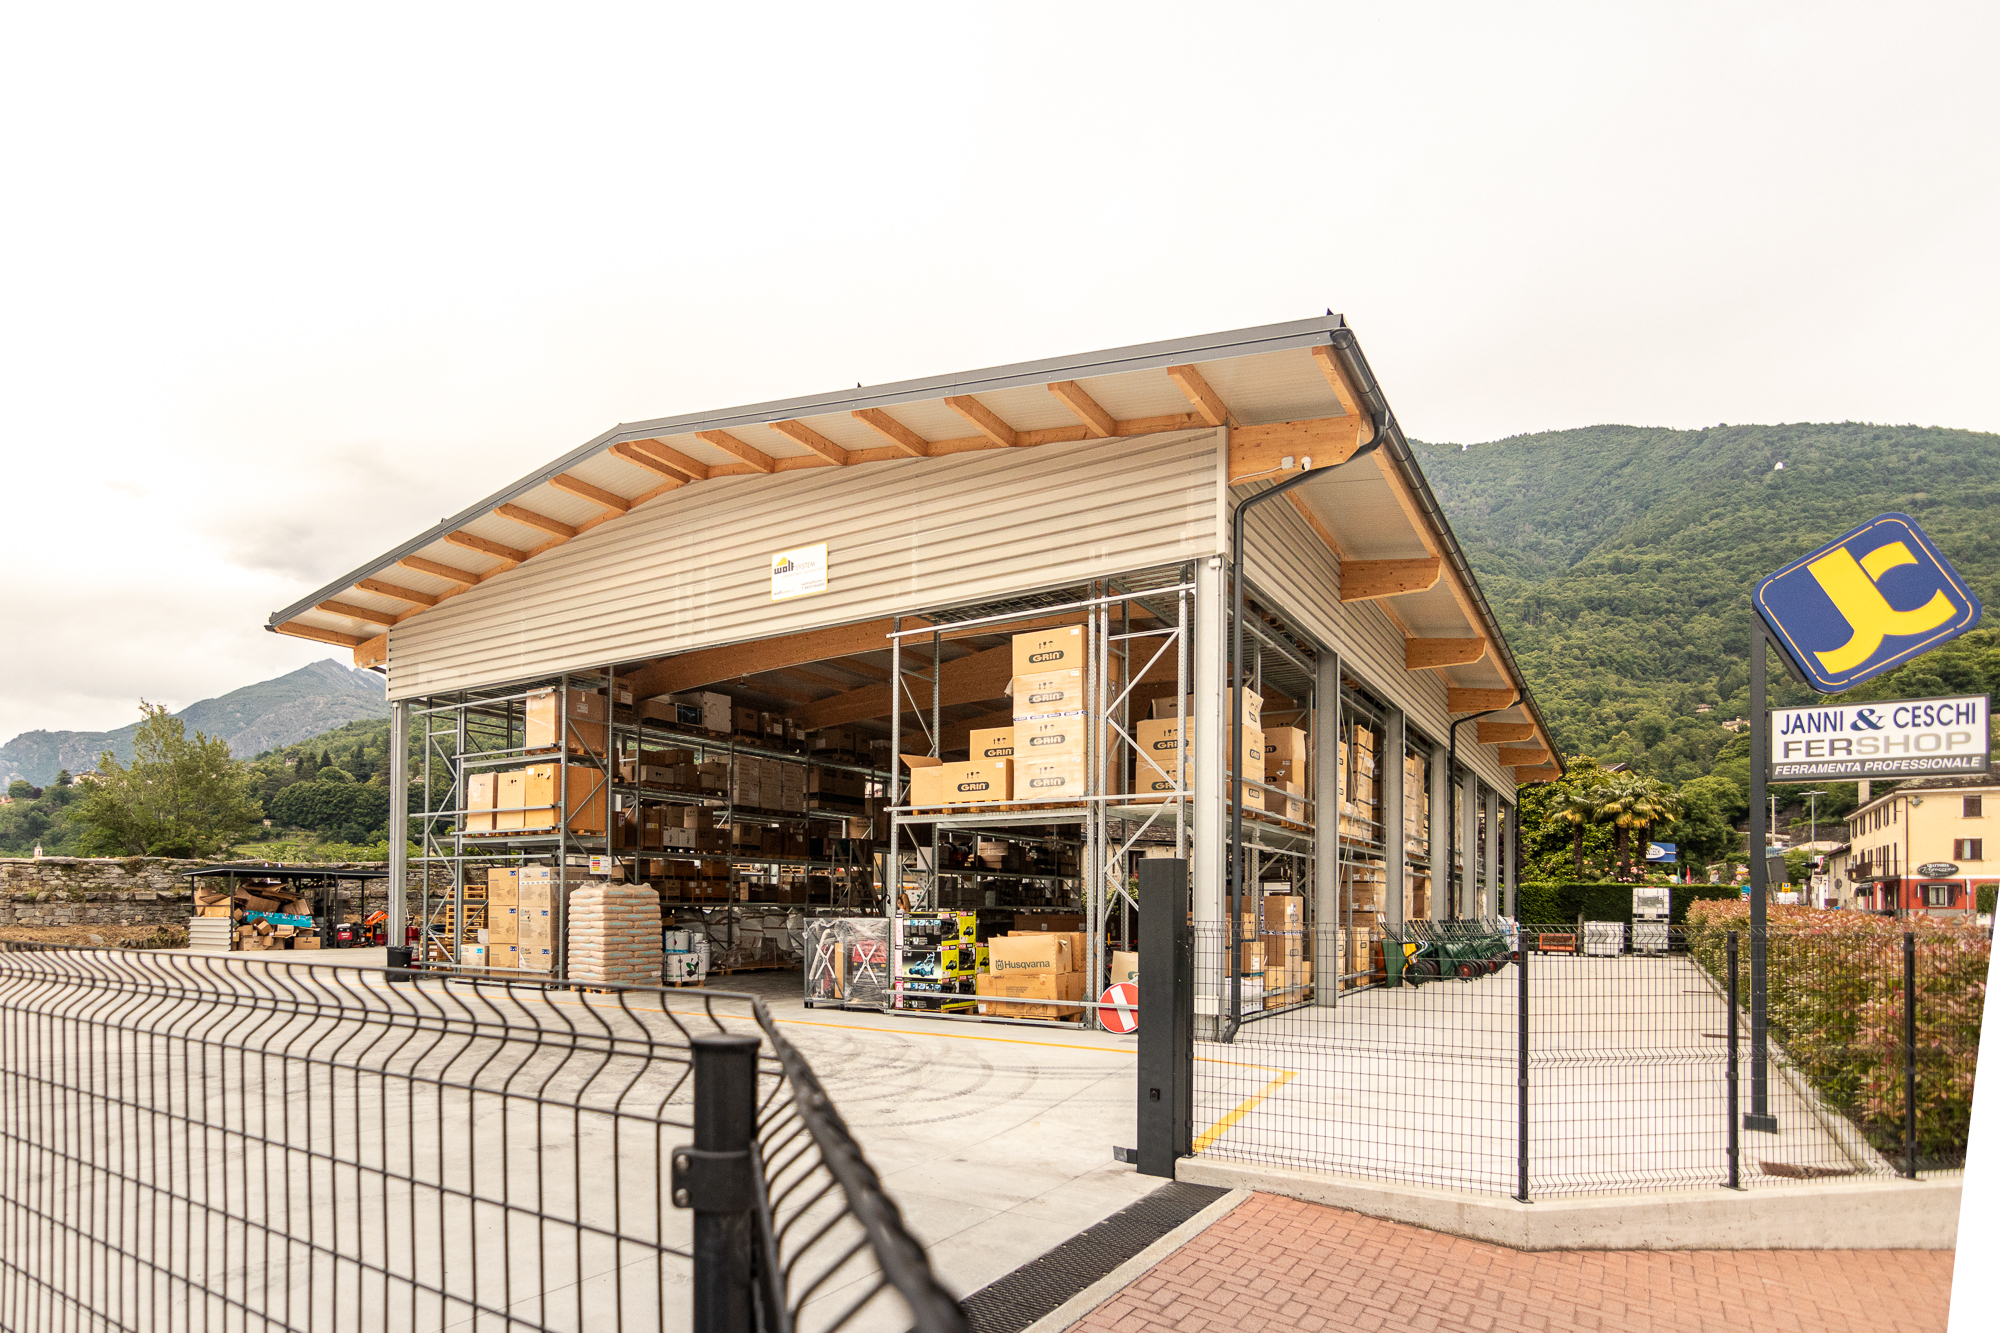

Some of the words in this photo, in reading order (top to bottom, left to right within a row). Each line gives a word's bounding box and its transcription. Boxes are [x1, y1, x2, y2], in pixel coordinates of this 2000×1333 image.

[774, 559, 794, 574] wolf
[795, 561, 815, 570] SYSTEM
[1033, 651, 1061, 662] GRIN
[1780, 710, 1844, 735] JANNI
[1850, 708, 1886, 732] &
[1892, 702, 1976, 729] CESCHI
[1783, 731, 1972, 759] FERSHOP
[987, 748, 1012, 757] GRIN
[1774, 761, 1862, 776] FERRAMENTA
[1864, 756, 1982, 772] PROFESSIONALE
[961, 782, 986, 791] GRIN
[1004, 960, 1050, 970] Husqvarna
